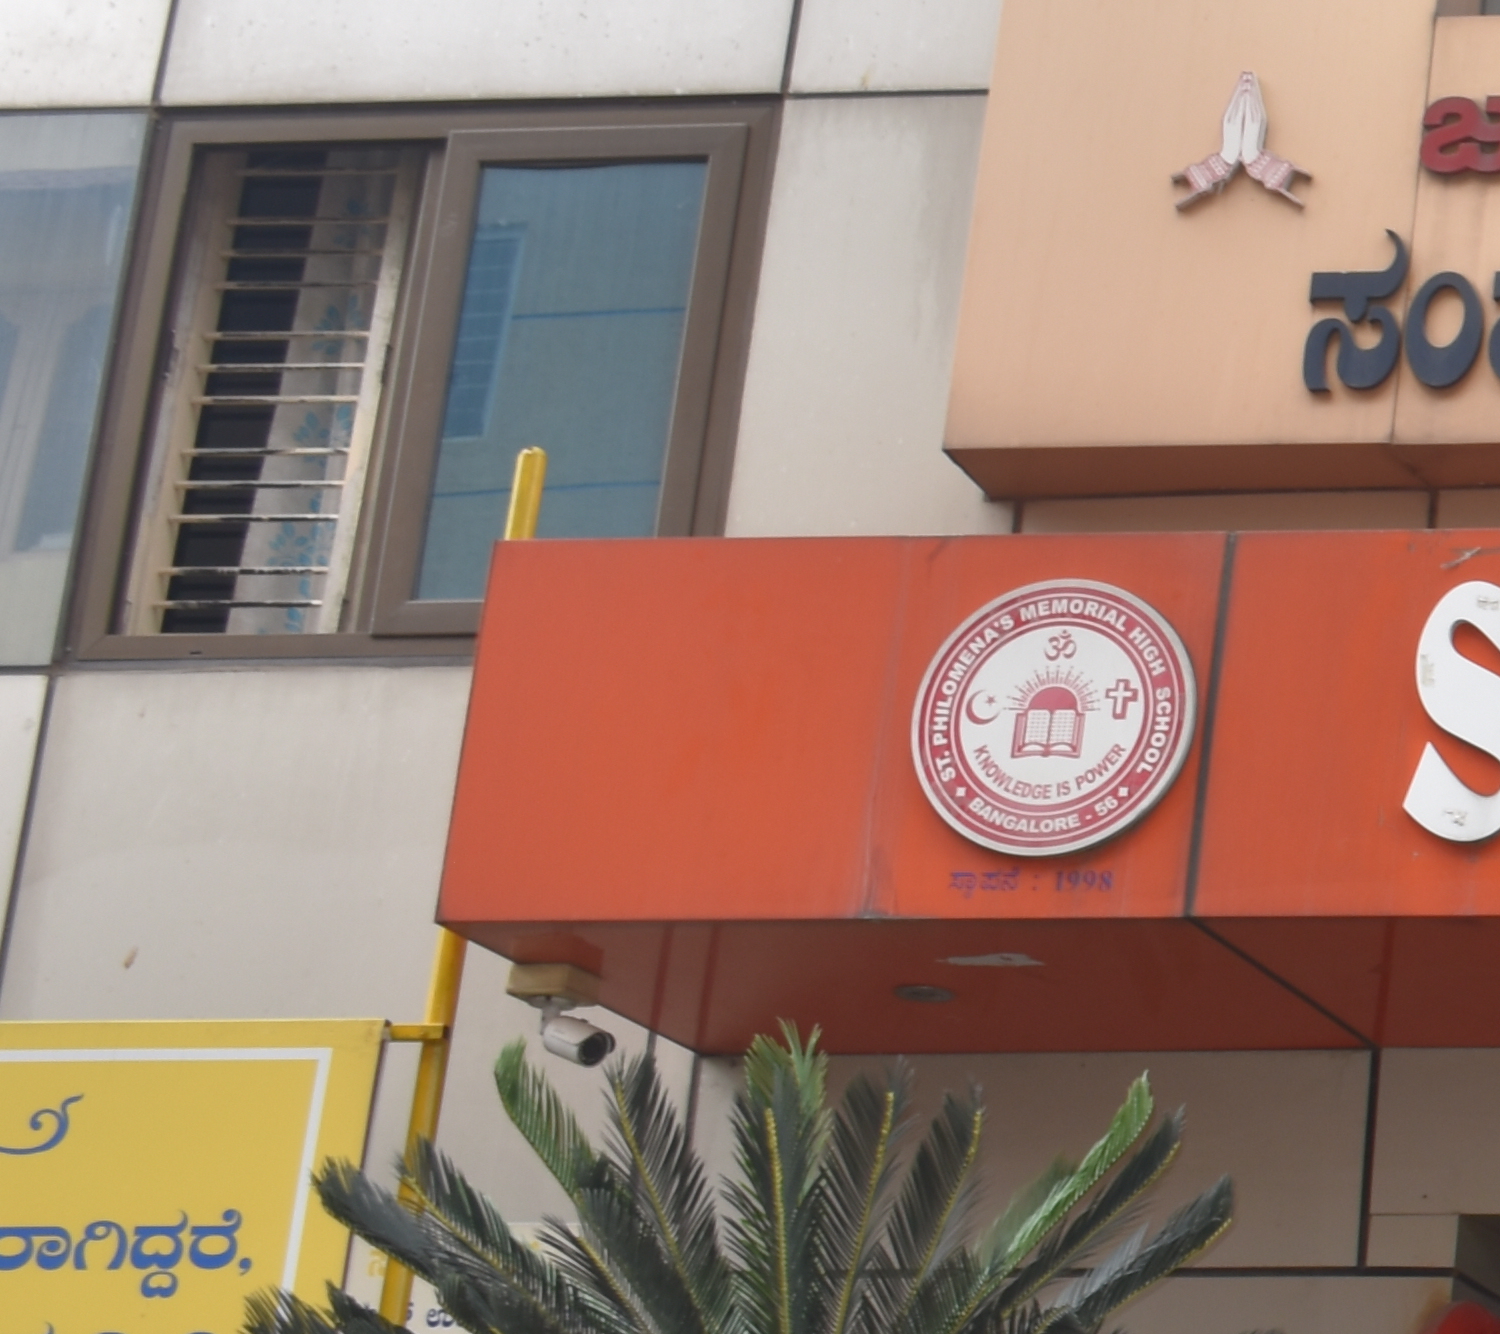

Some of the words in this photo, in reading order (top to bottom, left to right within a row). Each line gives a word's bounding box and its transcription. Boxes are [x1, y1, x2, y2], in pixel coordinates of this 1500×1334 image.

[1019, 598, 1128, 632] MEMORIAL
[1129, 626, 1167, 676] HIGH
[932, 613, 1015, 747] PHILOMENA'S
[1136, 687, 1172, 775] SCHOOL
[973, 744, 1052, 799] KNOWLEDGE
[1056, 782, 1071, 798] IS
[1074, 743, 1127, 790] POWER
[968, 796, 1082, 833] BANGALORE
[1095, 795, 1119, 817] 56
[1056, 870, 1114, 892] 1998
